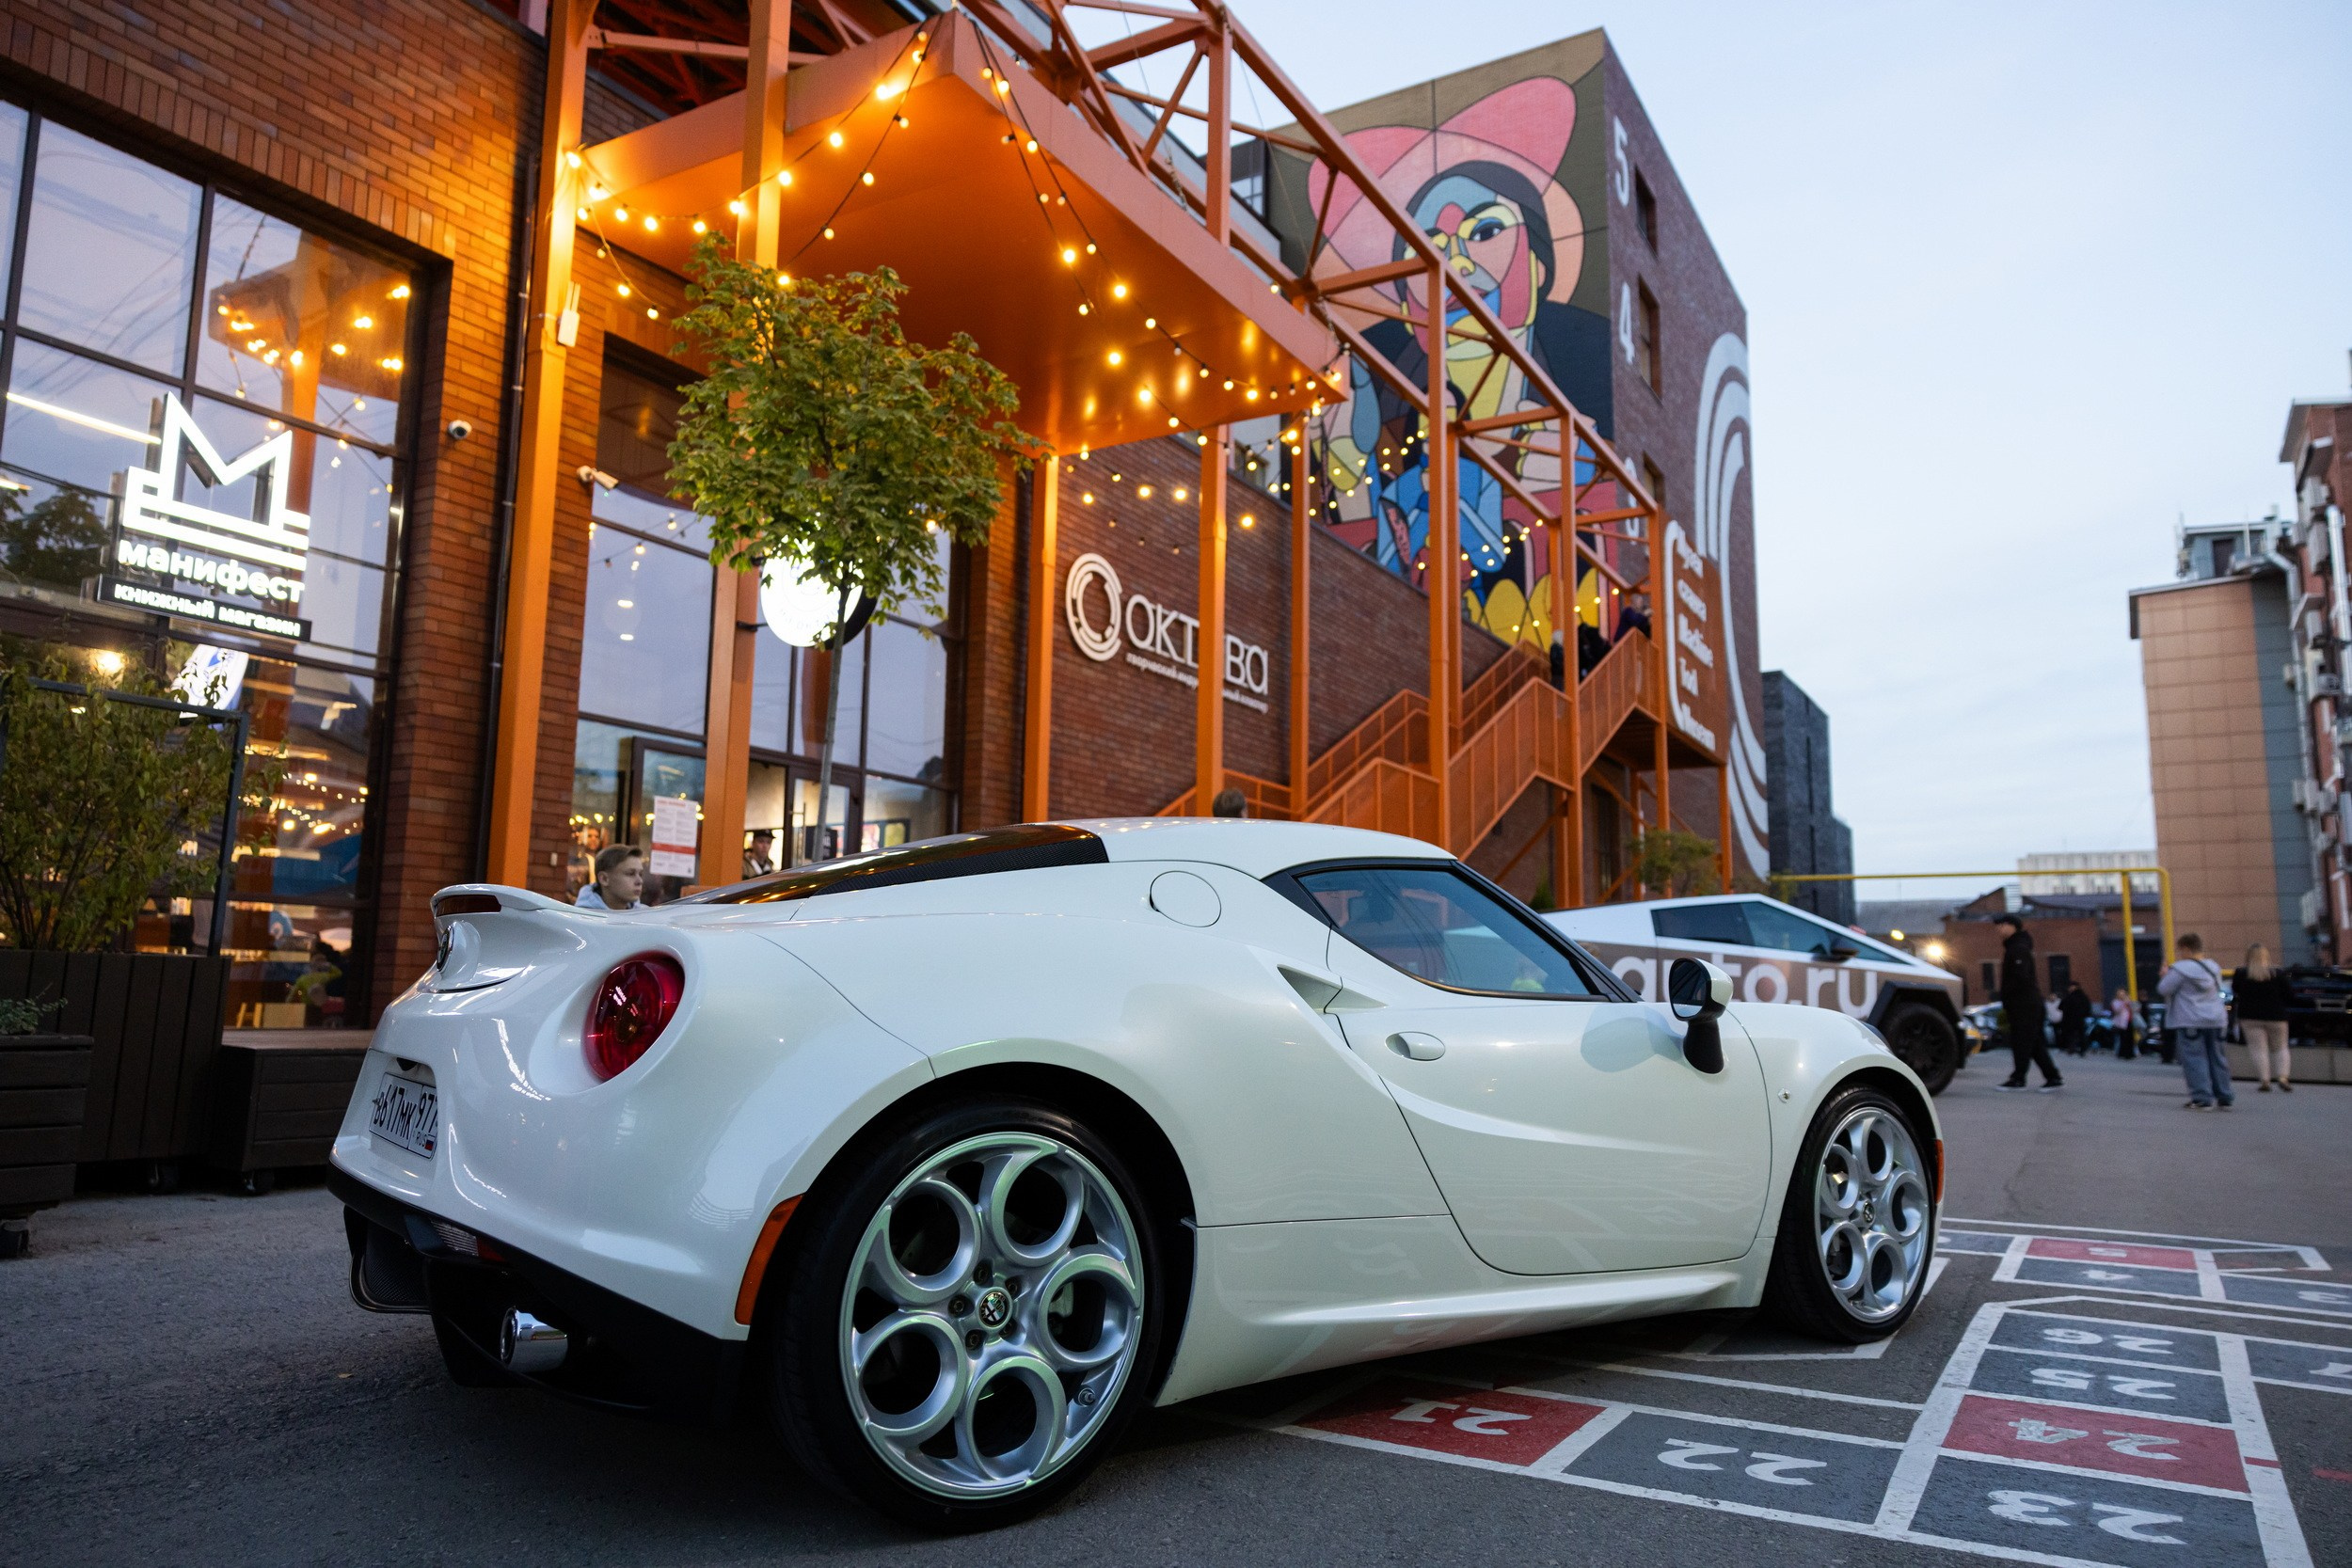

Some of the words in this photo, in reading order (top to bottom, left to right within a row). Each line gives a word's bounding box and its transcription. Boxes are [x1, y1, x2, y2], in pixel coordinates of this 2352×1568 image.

[1613, 115, 1630, 207] 5
[1619, 282, 1635, 365] 4
[118, 539, 305, 603] манифест
[114, 583, 215, 619] книжный
[218, 606, 301, 638] магазин
[1612, 953, 1877, 1019] ao.ru
[2042, 1328, 2174, 1354] 26
[2030, 1369, 2176, 1399] 25
[1390, 1397, 1533, 1434] 21
[2009, 1418, 2180, 1460] 24
[1658, 1438, 1828, 1485] 22
[1987, 1490, 2189, 1545] 23
